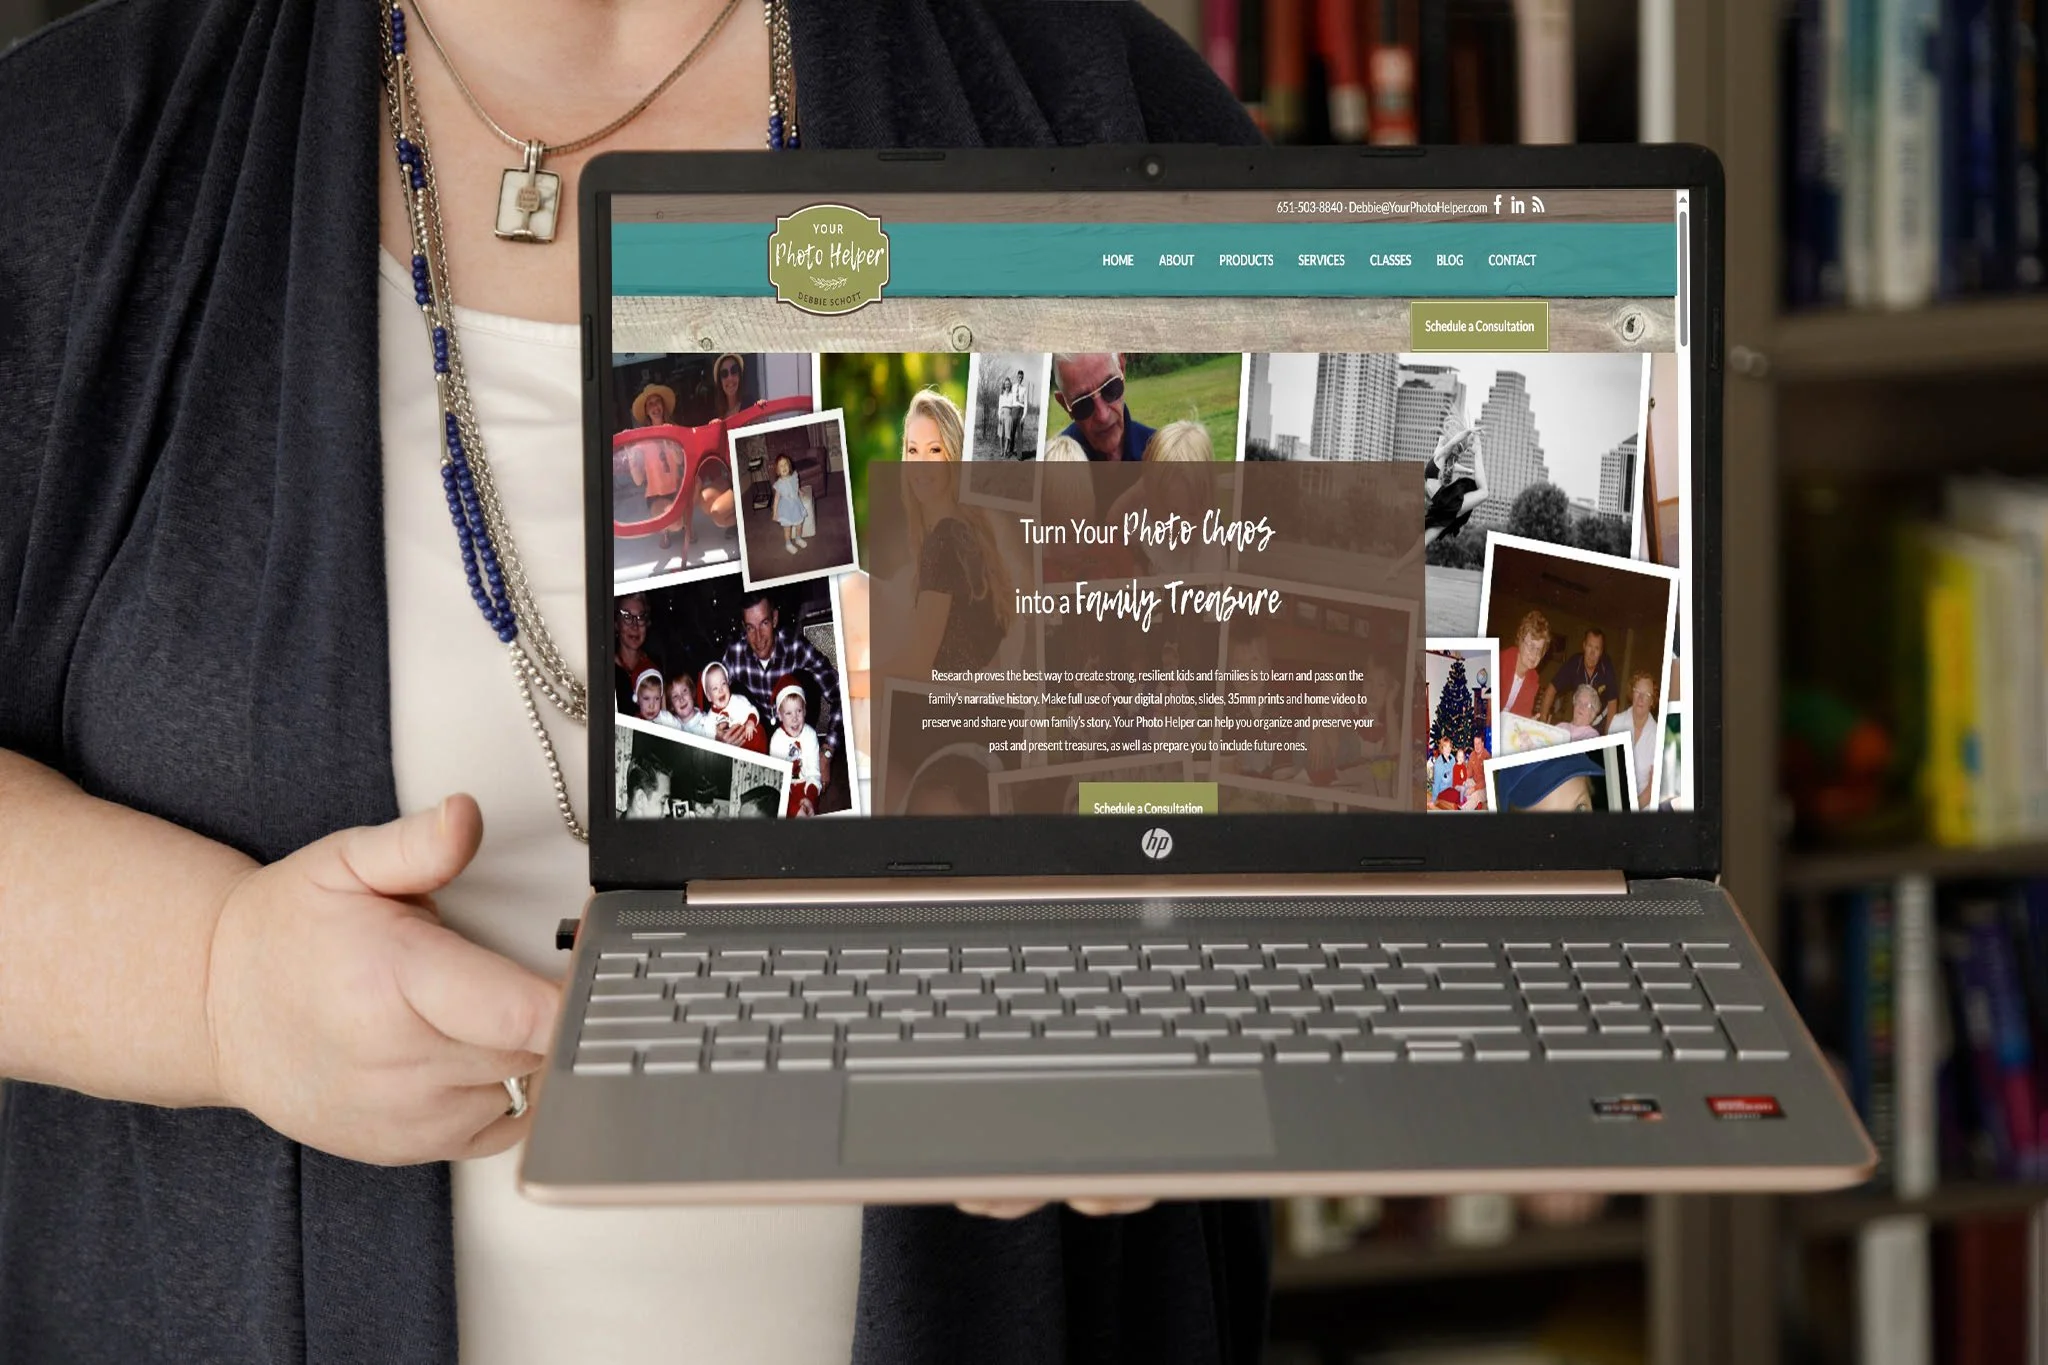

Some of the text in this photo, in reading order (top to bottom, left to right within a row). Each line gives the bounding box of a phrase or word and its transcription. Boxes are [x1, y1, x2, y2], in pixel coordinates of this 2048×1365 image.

[1276, 200, 1488, 216] 651-503-8840 Debbie@YourPhotoHelper.com
[1510, 195, 1525, 214] in
[812, 223, 844, 235] YOUR
[775, 240, 885, 273] Photo Helper
[1102, 253, 1135, 267] HOME
[1158, 253, 1195, 267] ABOUT
[1219, 253, 1274, 267] PRODUCTS
[1297, 253, 1346, 267] SERVICES
[1369, 253, 1413, 267] CLASSES
[1436, 253, 1465, 267] BLOG
[1487, 253, 1538, 267] CONTACT
[798, 291, 862, 306] DEBBIE SCHOTT
[1424, 319, 1535, 333] Schedule a Consultation
[1019, 508, 1276, 552] Turn Your Photo Chaos
[1015, 579, 1282, 633] into a Family Treasure
[931, 669, 1364, 685] Research proves the best way to create strong, resilient kids and families is to learn and pass on the
[963, 692, 1006, 705] narrative
[1006, 692, 1041, 708] history.
[1041, 692, 1067, 705] Make
[1067, 692, 1083, 705] full
[1083, 696, 1101, 705] use
[1100, 692, 1112, 705] of
[1111, 696, 1134, 708] your
[1133, 692, 1163, 708] digital
[1164, 692, 1198, 708] photos,
[1198, 692, 1227, 708] slides,
[1227, 692, 1257, 705] 35mm
[1257, 692, 1285, 708] prints
[1285, 692, 1303, 705] and
[1303, 692, 1331, 705] home
[1330, 692, 1357, 705] video
[1357, 692, 1368, 705] to
[921, 719, 962, 731] preserve
[962, 715, 980, 728] and
[980, 715, 1007, 728] share
[1007, 719, 1030, 731] your
[1029, 719, 1050, 728] own
[1086, 715, 1113, 731] story.
[1112, 715, 1135, 728] Your
[1135, 715, 1164, 728] Photo
[1164, 715, 1196, 731] Helper
[1196, 719, 1213, 728] can
[1214, 715, 1235, 731] help
[1235, 719, 1253, 731] you
[1252, 715, 1293, 731] organize
[1293, 715, 1311, 728] and
[1311, 719, 1352, 731] preserve
[1352, 719, 1375, 731] your
[988, 739, 1308, 755] past and present treasures, as well as prepare you to include future ones.
[1093, 802, 1204, 815] Schedule a Consultation
[1142, 827, 1173, 859] hp
